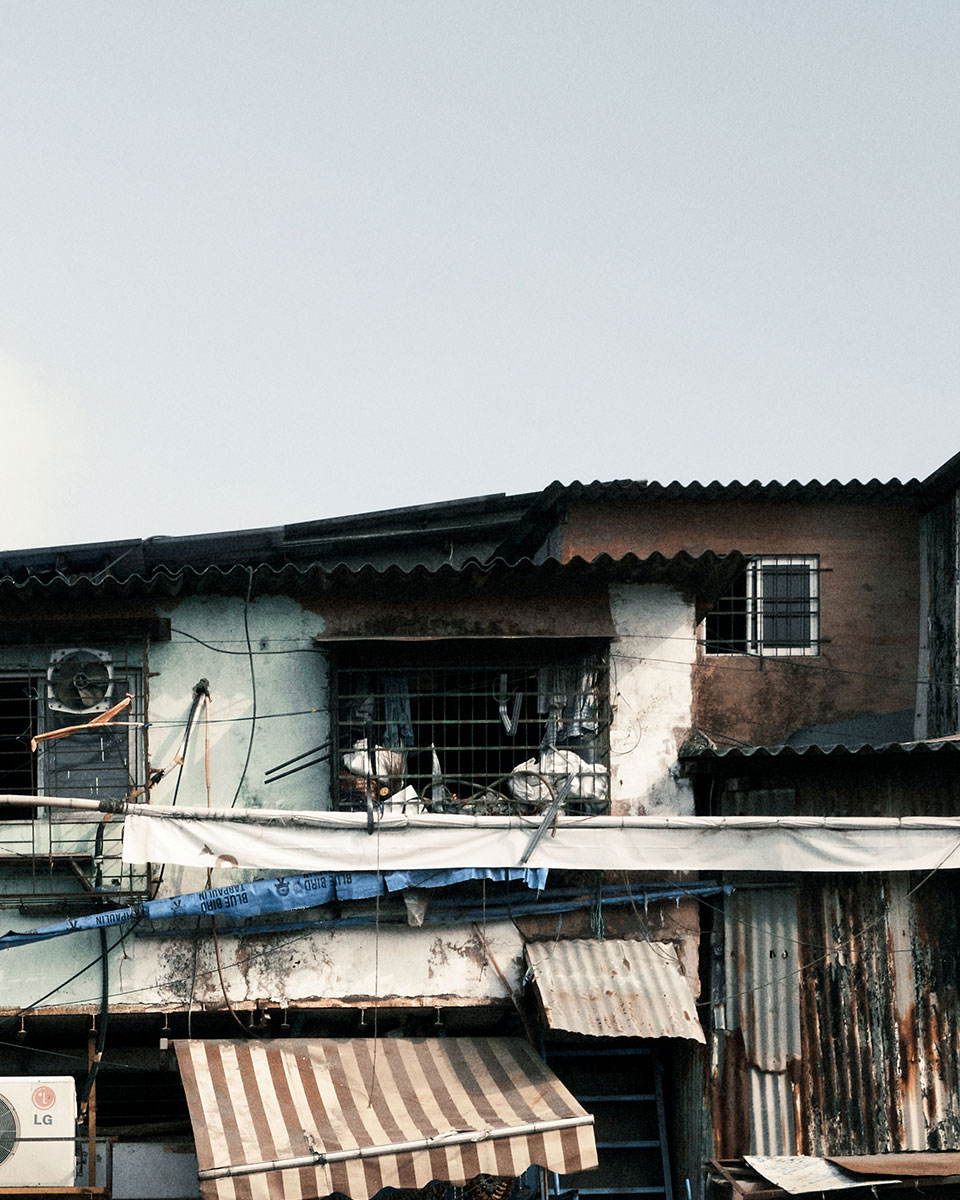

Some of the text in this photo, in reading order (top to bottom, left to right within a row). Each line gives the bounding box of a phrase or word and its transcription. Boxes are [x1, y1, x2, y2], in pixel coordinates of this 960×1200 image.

[304, 877, 327, 891] BIRD
[199, 885, 246, 901] TARPAULIN
[201, 892, 249, 913] BLUE BIRD
[33, 1114, 53, 1125] LG
